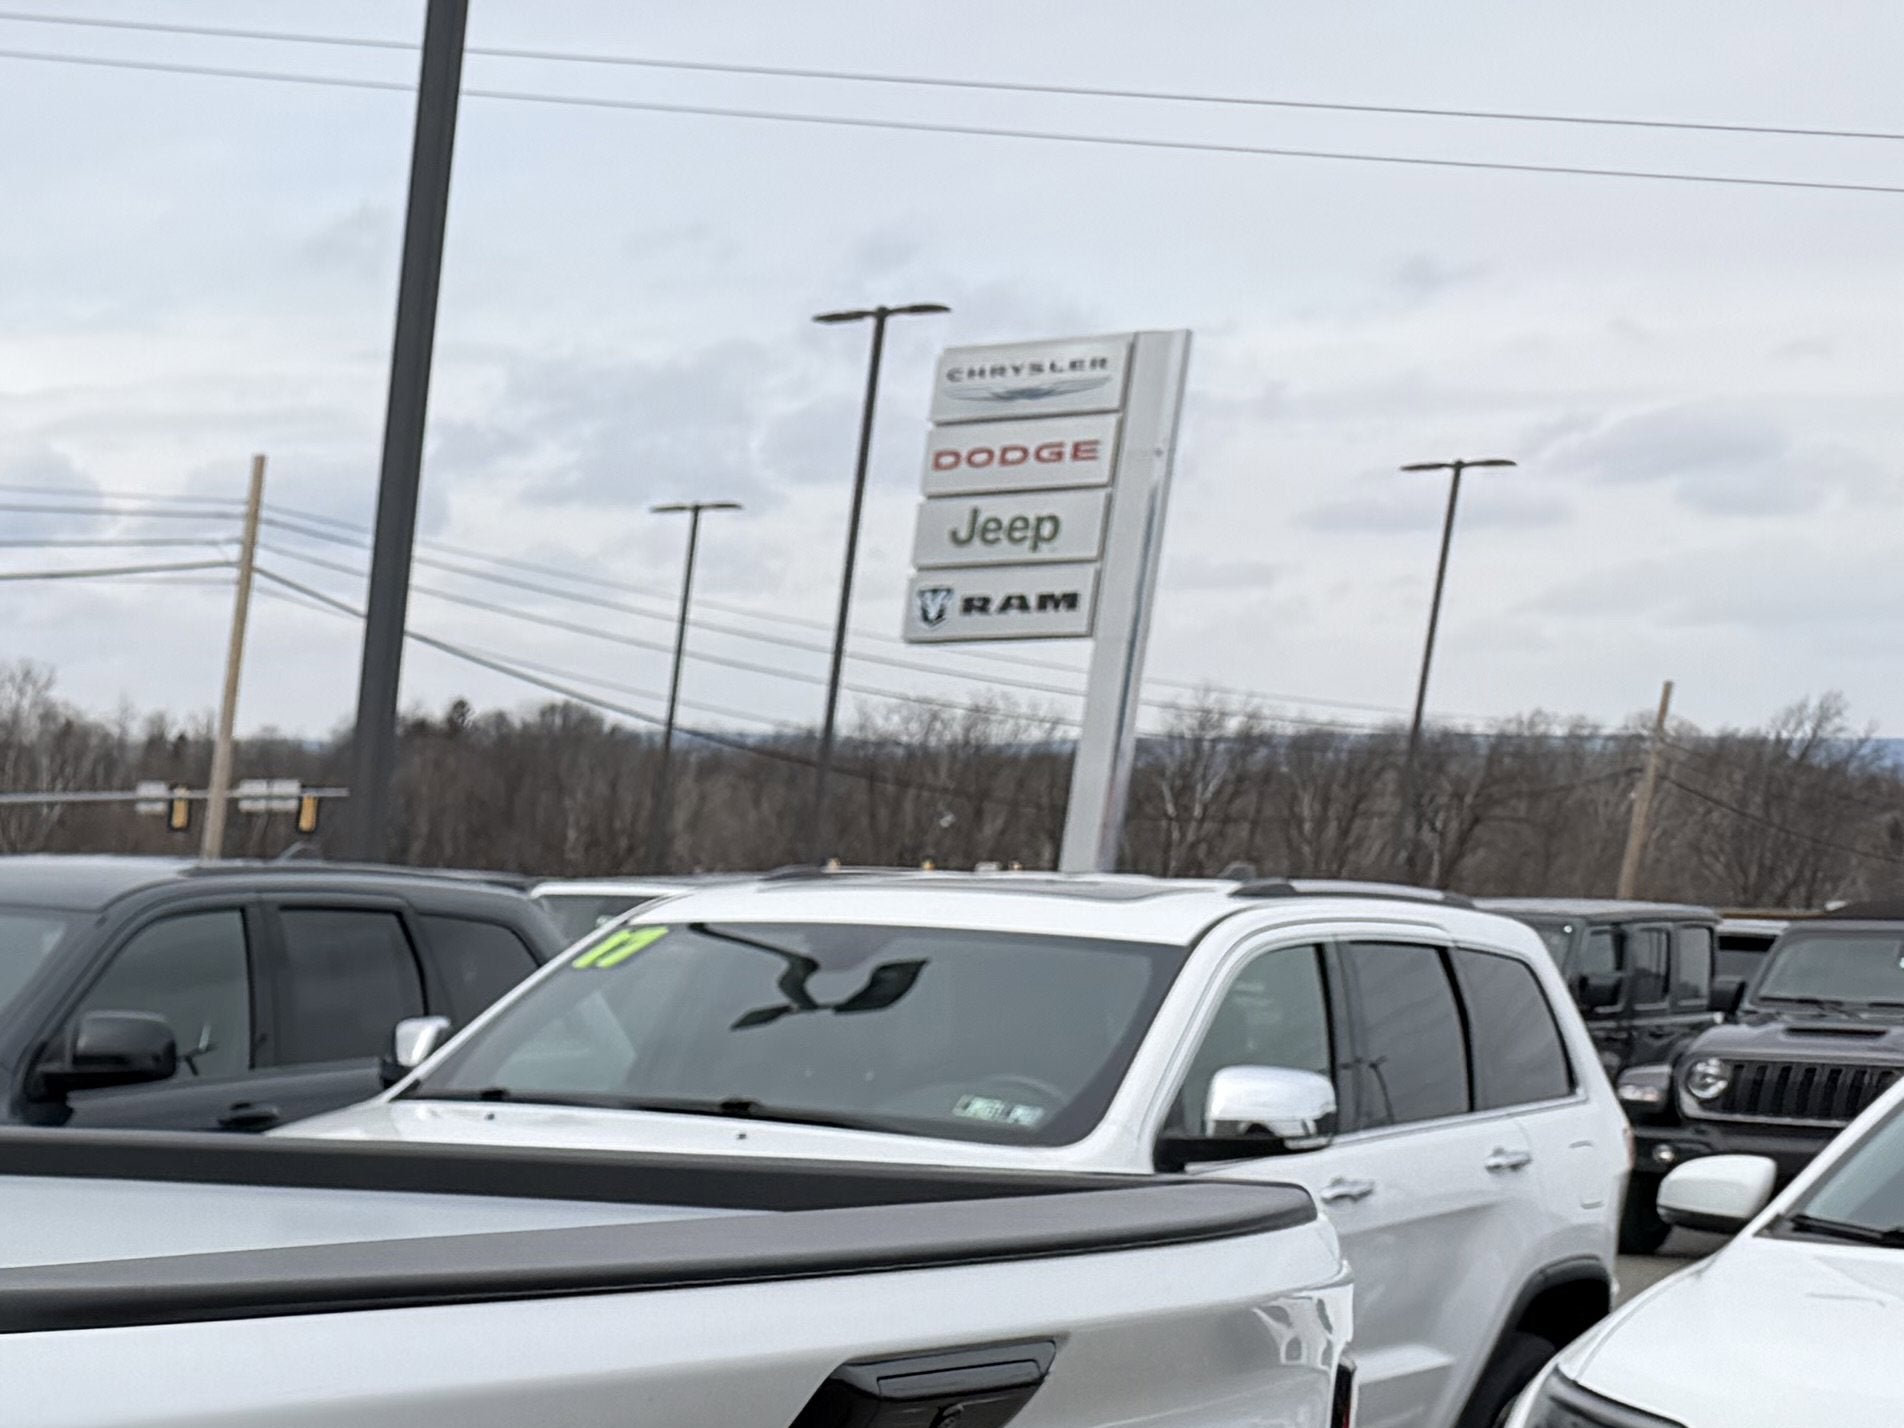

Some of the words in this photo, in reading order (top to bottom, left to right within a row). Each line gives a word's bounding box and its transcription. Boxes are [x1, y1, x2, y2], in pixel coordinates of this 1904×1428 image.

[946, 357, 1107, 382] CHRYSLER
[932, 439, 1101, 472] DODGE
[950, 507, 1060, 553] Jeep
[960, 592, 1080, 616] RAM
